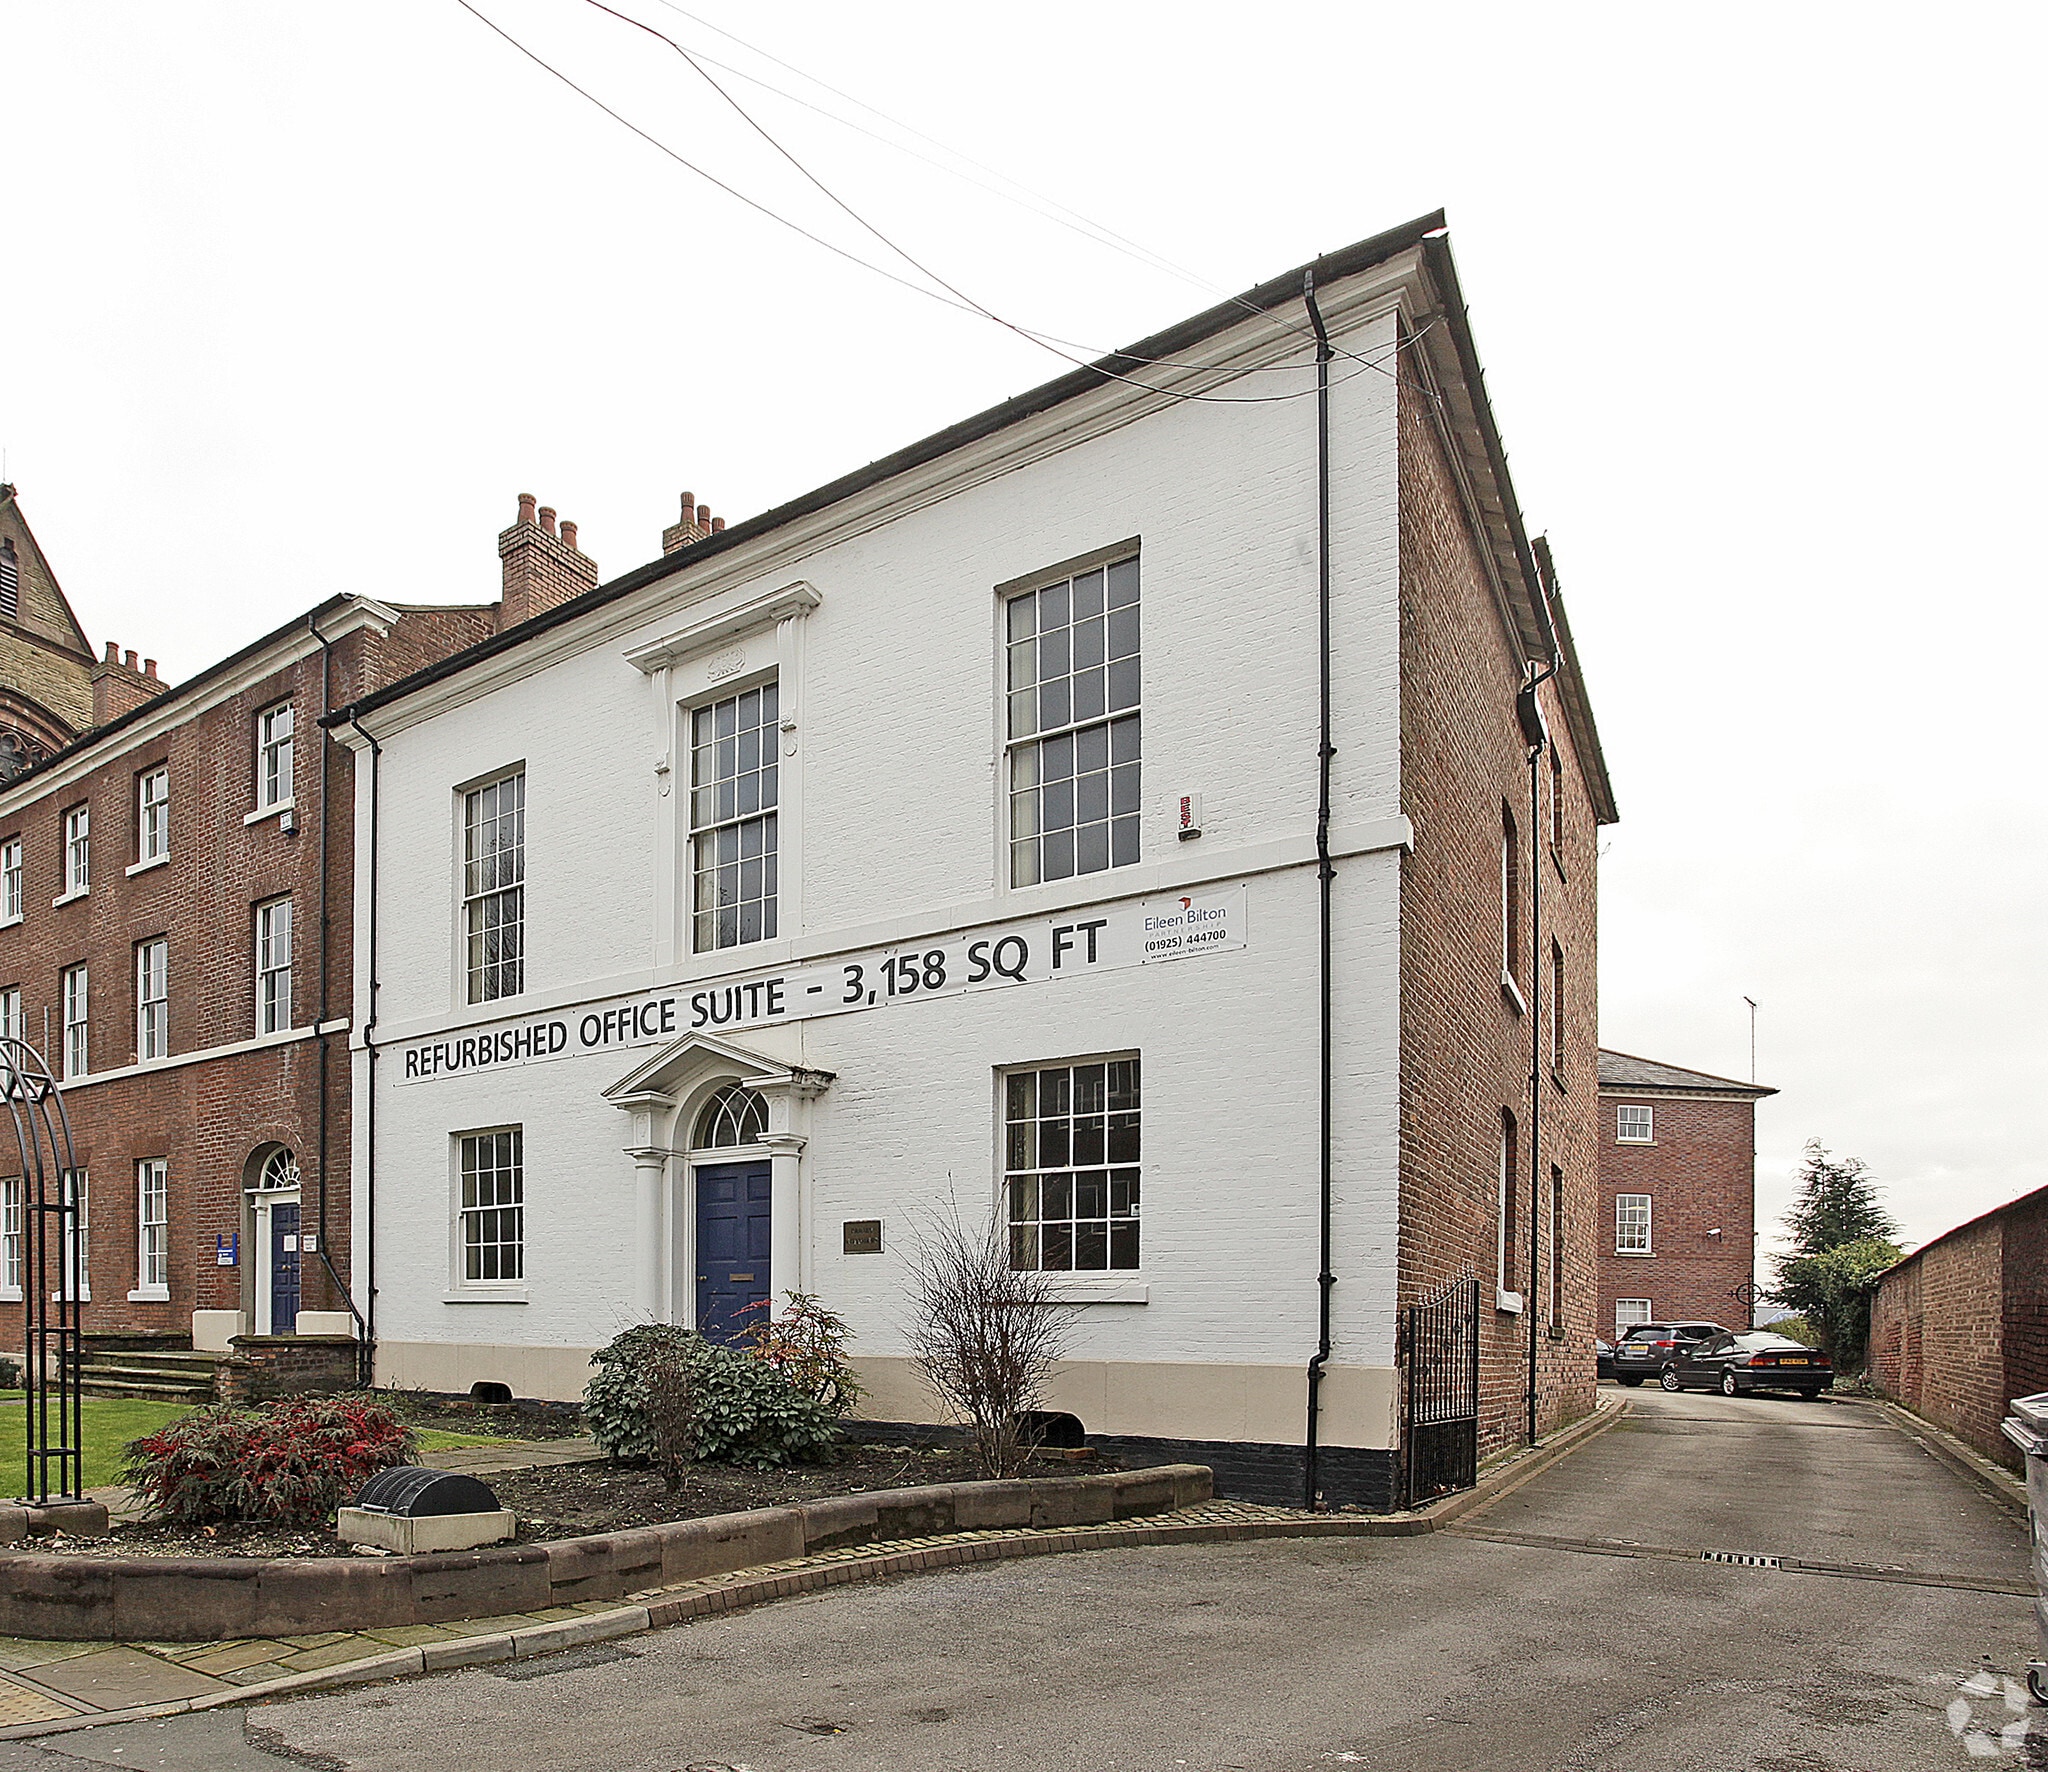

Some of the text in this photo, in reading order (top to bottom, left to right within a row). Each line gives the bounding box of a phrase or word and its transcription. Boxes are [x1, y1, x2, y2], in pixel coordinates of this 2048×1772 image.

[1144, 908, 1226, 931] Eileen Bilton
[1149, 922, 1222, 938] PARTNERSHIP
[1145, 929, 1226, 952] (01925) 444700
[405, 918, 1108, 1078] REFURBISHED OFFICE SUITE - 3,158 SQ FT
